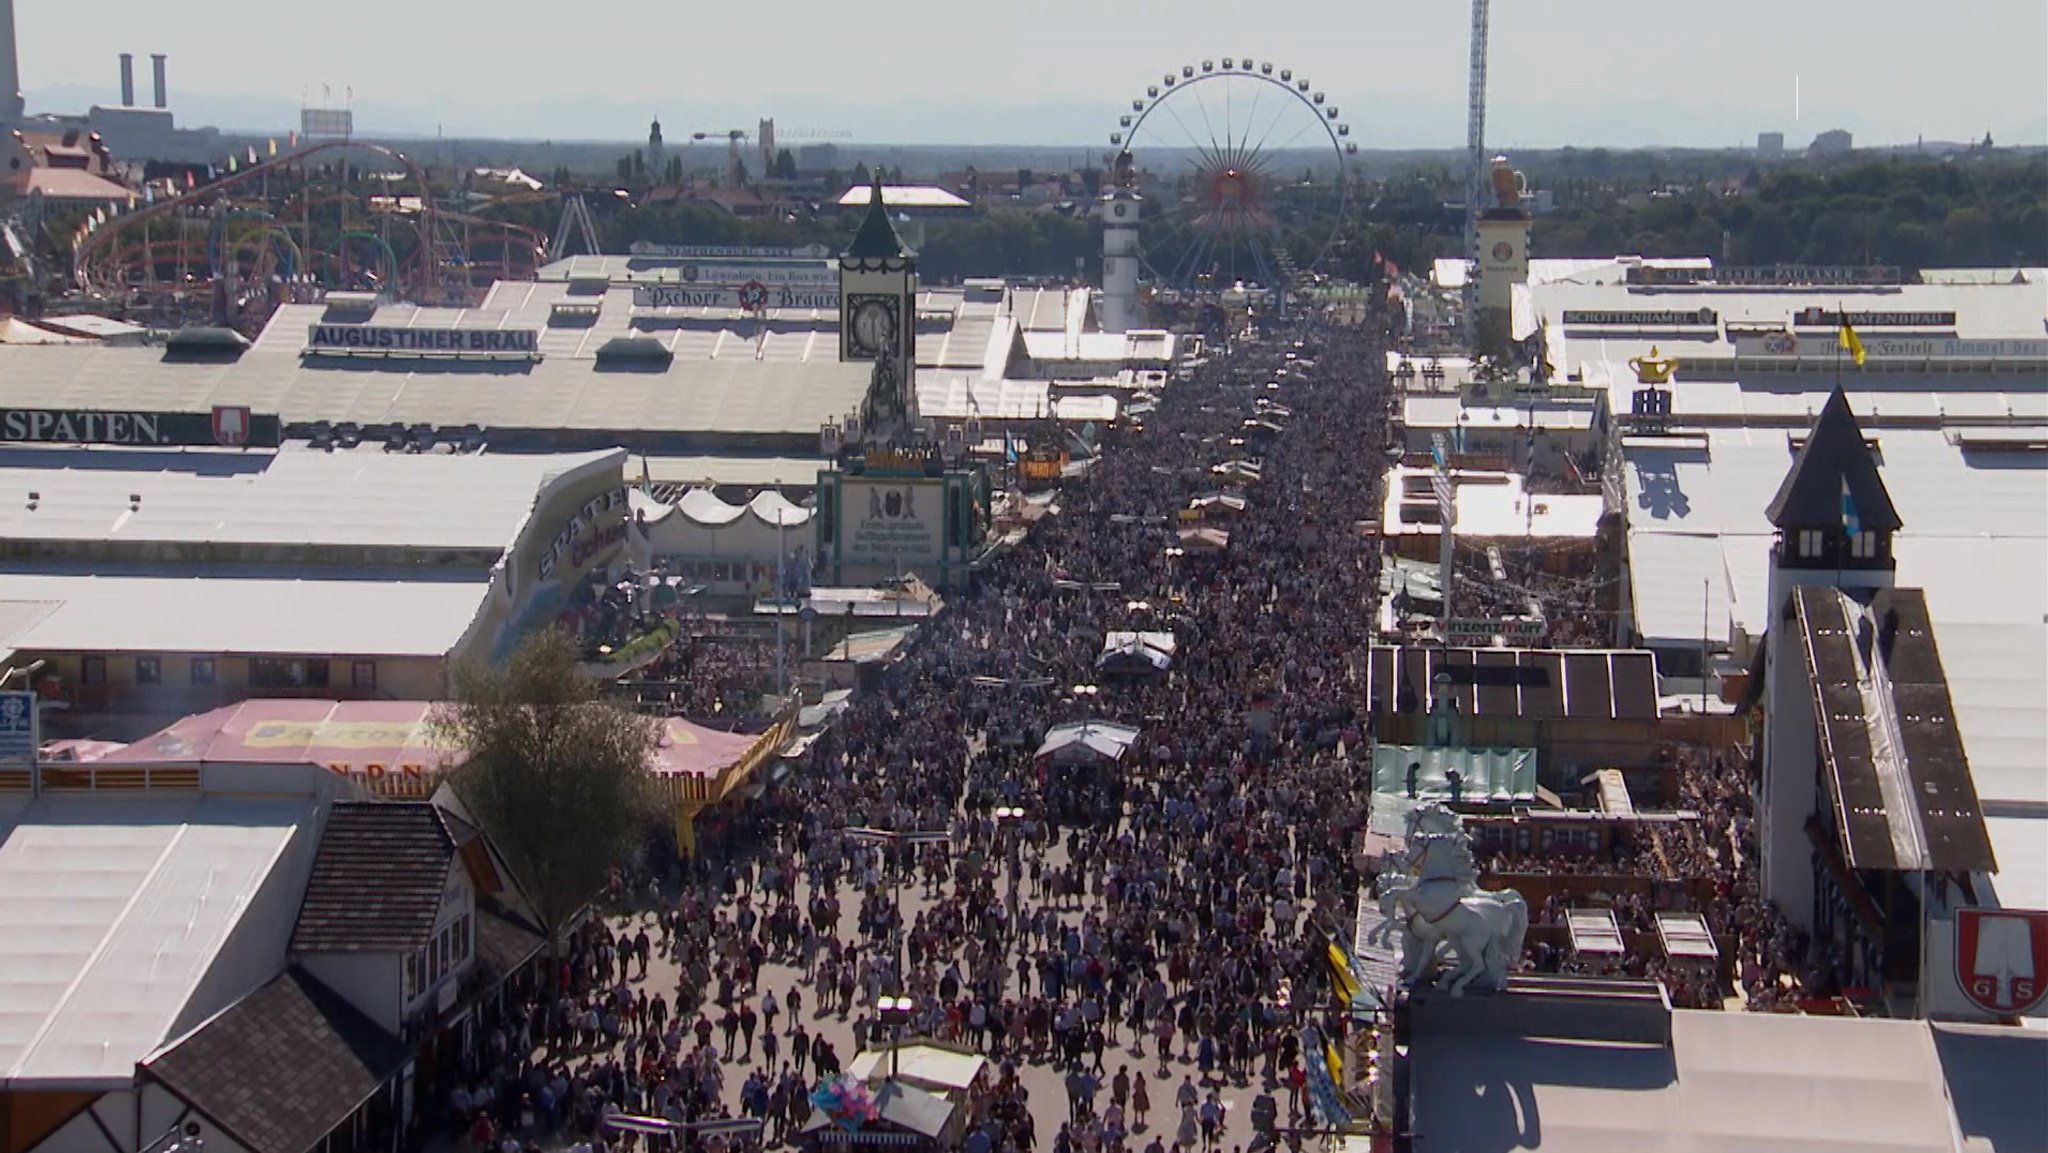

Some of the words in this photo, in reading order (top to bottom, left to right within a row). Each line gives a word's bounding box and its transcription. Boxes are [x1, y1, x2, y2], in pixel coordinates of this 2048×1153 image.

[1565, 311, 1689, 325] SCHOTTENHAMEL
[312, 326, 463, 349] AUGUSTINER
[470, 329, 533, 351] BRÄU
[4, 410, 170, 443] SPATEN.
[1435, 620, 1543, 635] vinzenzmurr
[1973, 979, 1990, 996] G
[2015, 981, 2033, 999] S
